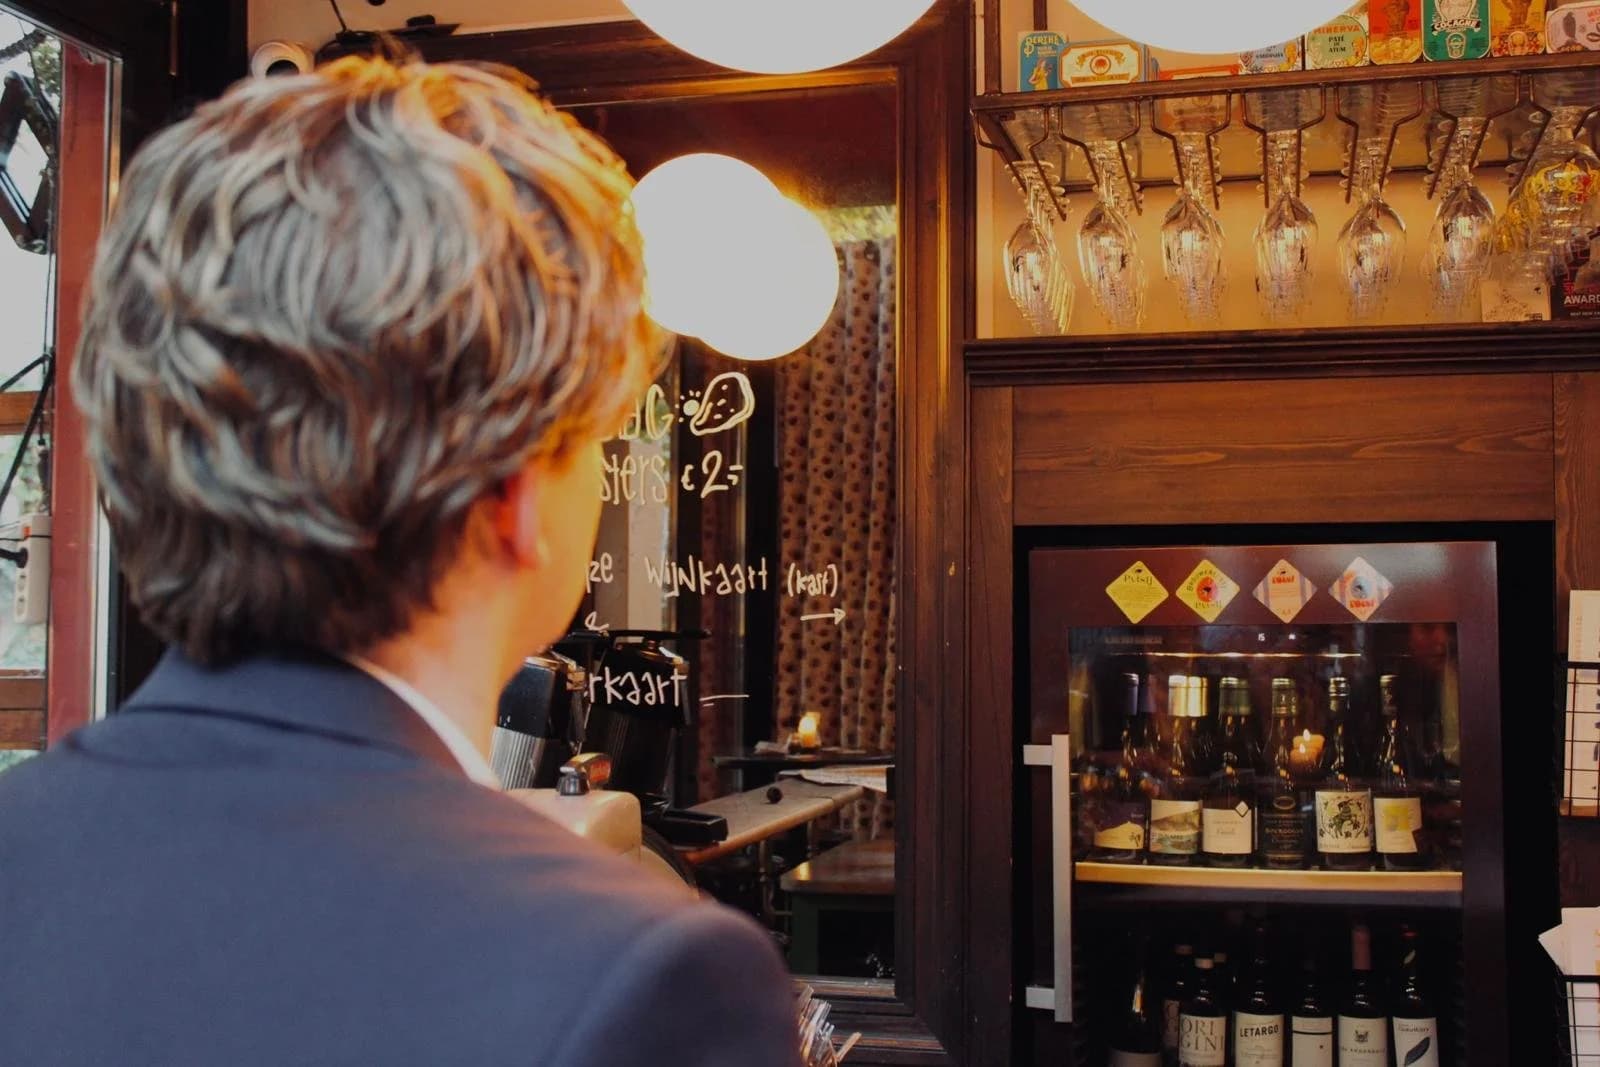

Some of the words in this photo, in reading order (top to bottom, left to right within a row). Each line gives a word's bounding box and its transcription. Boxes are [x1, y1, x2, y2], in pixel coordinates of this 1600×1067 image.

[1312, 24, 1361, 35] MINERVA
[1434, 19, 1477, 31] COCAGNE
[1024, 34, 1059, 57] BERTHE
[584, 666, 688, 708] rkaart
[1181, 1016, 1214, 1036] ORI
[1239, 1024, 1279, 1038] LETARGO
